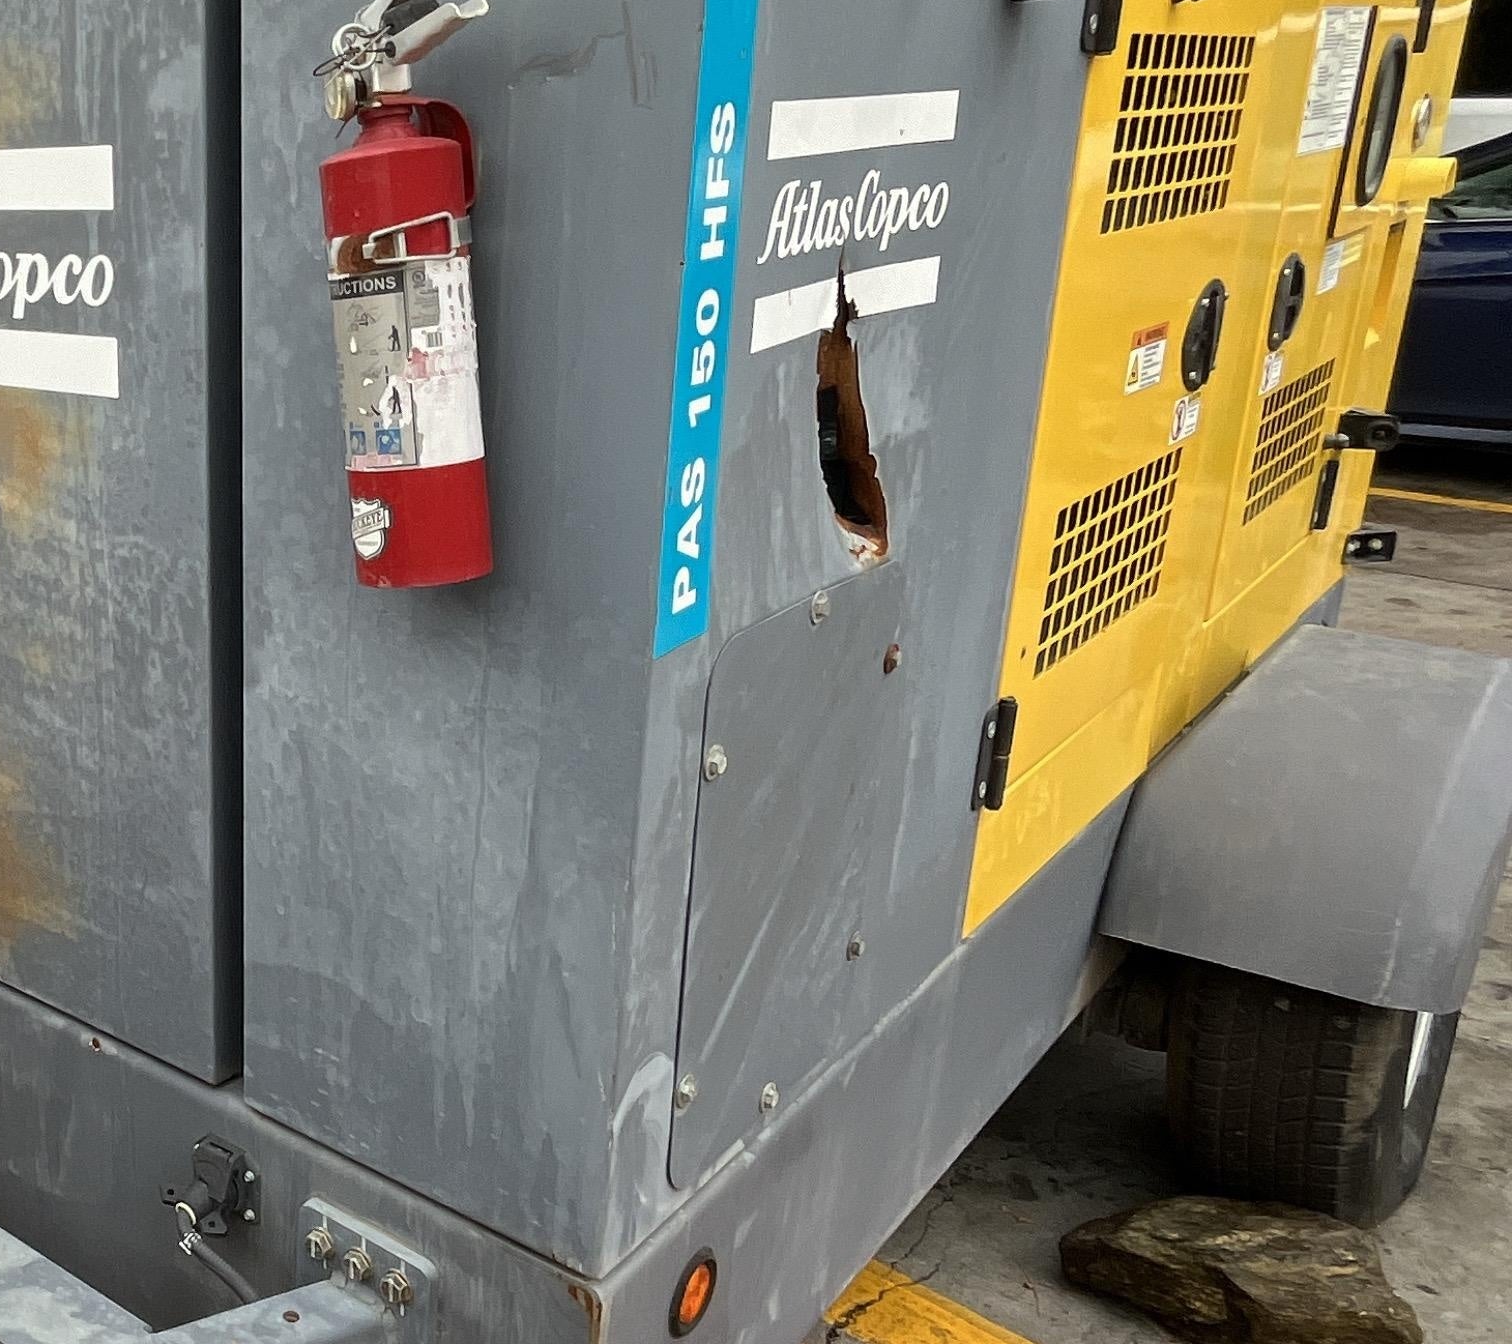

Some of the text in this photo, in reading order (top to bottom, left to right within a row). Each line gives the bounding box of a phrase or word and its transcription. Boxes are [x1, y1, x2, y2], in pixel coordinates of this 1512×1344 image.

[672, 102, 736, 614] PAS 150 HFS
[756, 169, 949, 265] Atlas Copco
